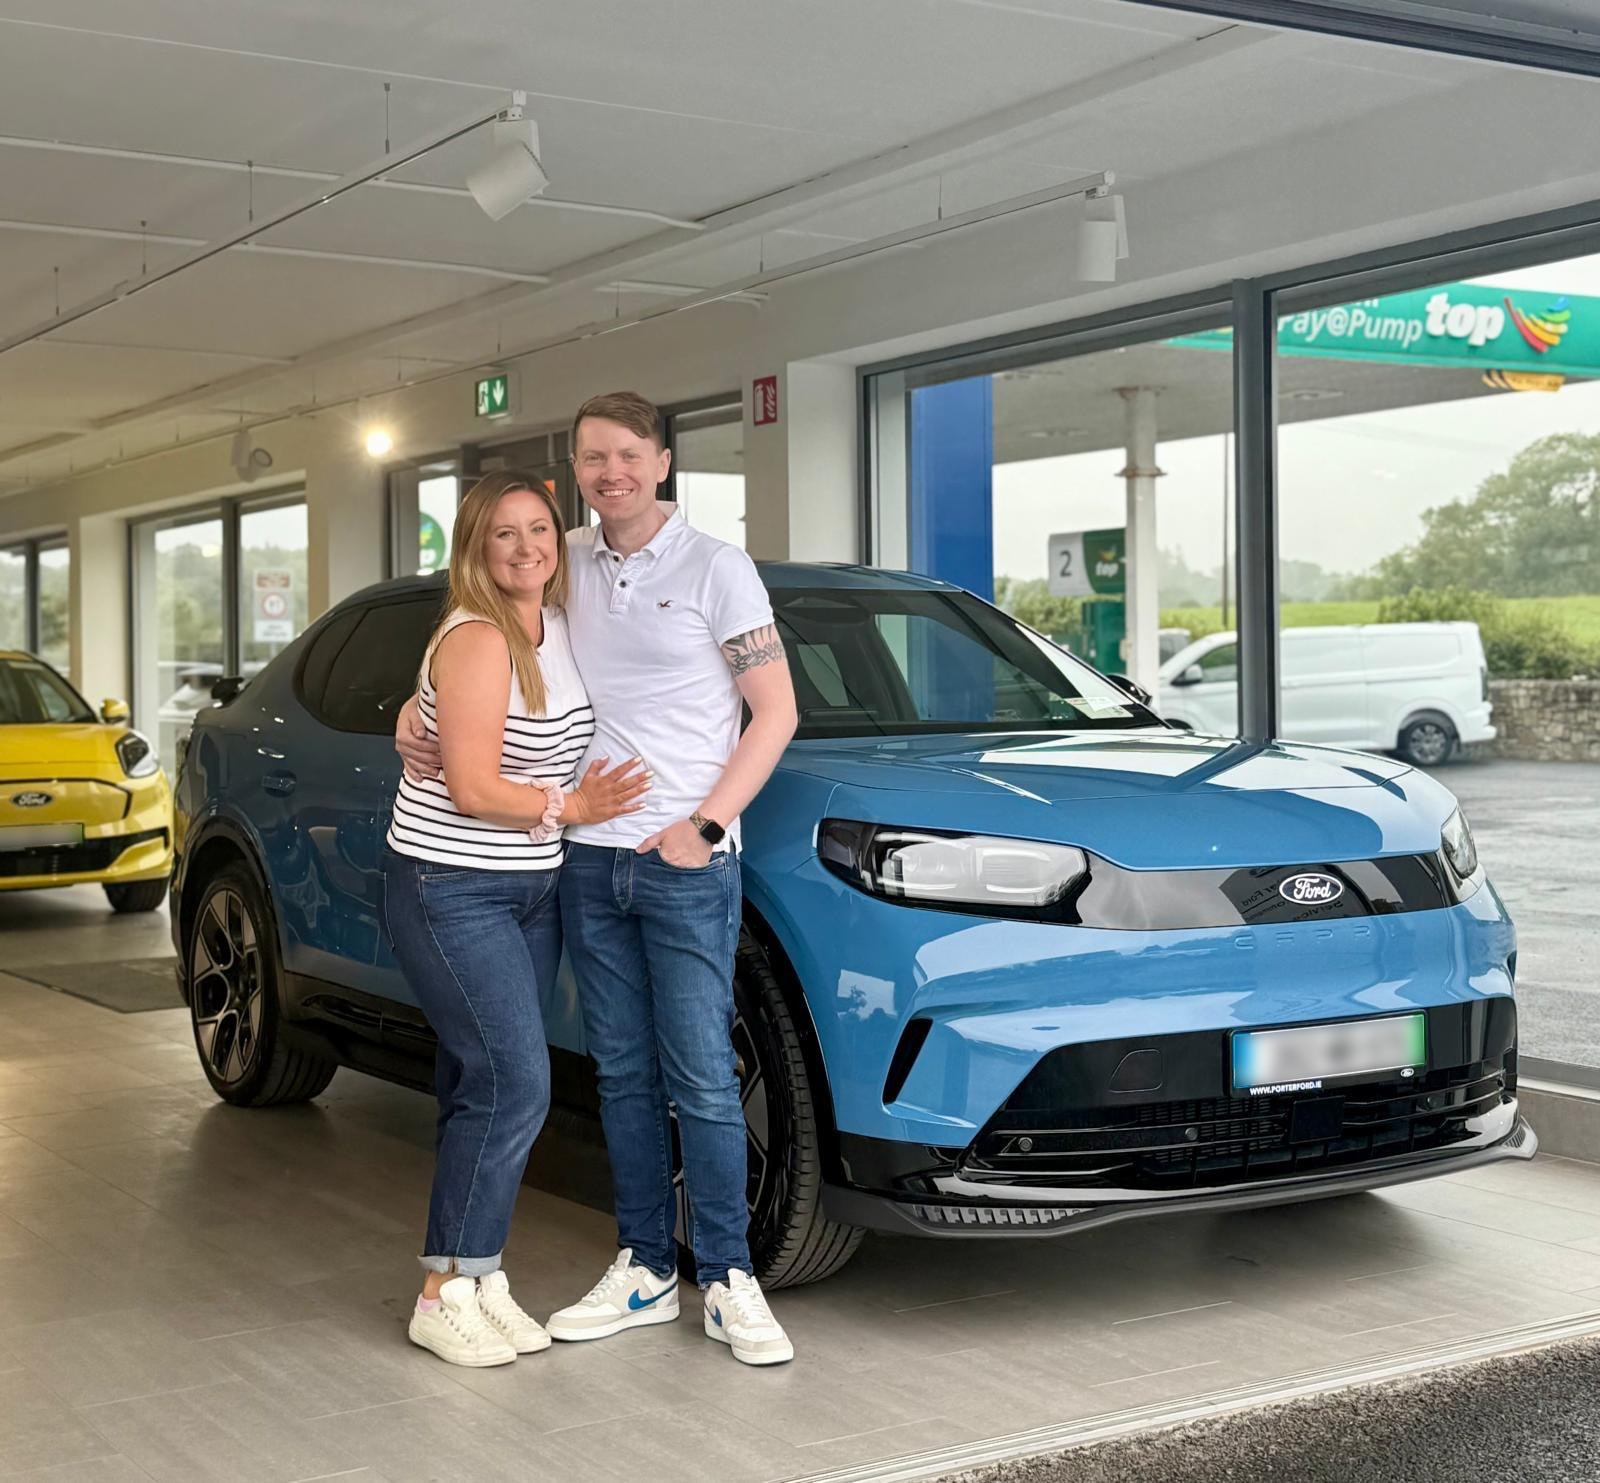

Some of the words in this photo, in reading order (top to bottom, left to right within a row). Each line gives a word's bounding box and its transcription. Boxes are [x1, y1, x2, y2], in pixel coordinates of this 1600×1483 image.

[1425, 292, 1505, 346] top
[1059, 550, 1072, 578] 2
[1292, 877, 1332, 900] Ford
[1249, 1080, 1323, 1096] WWW.PORTERFORD.IE
